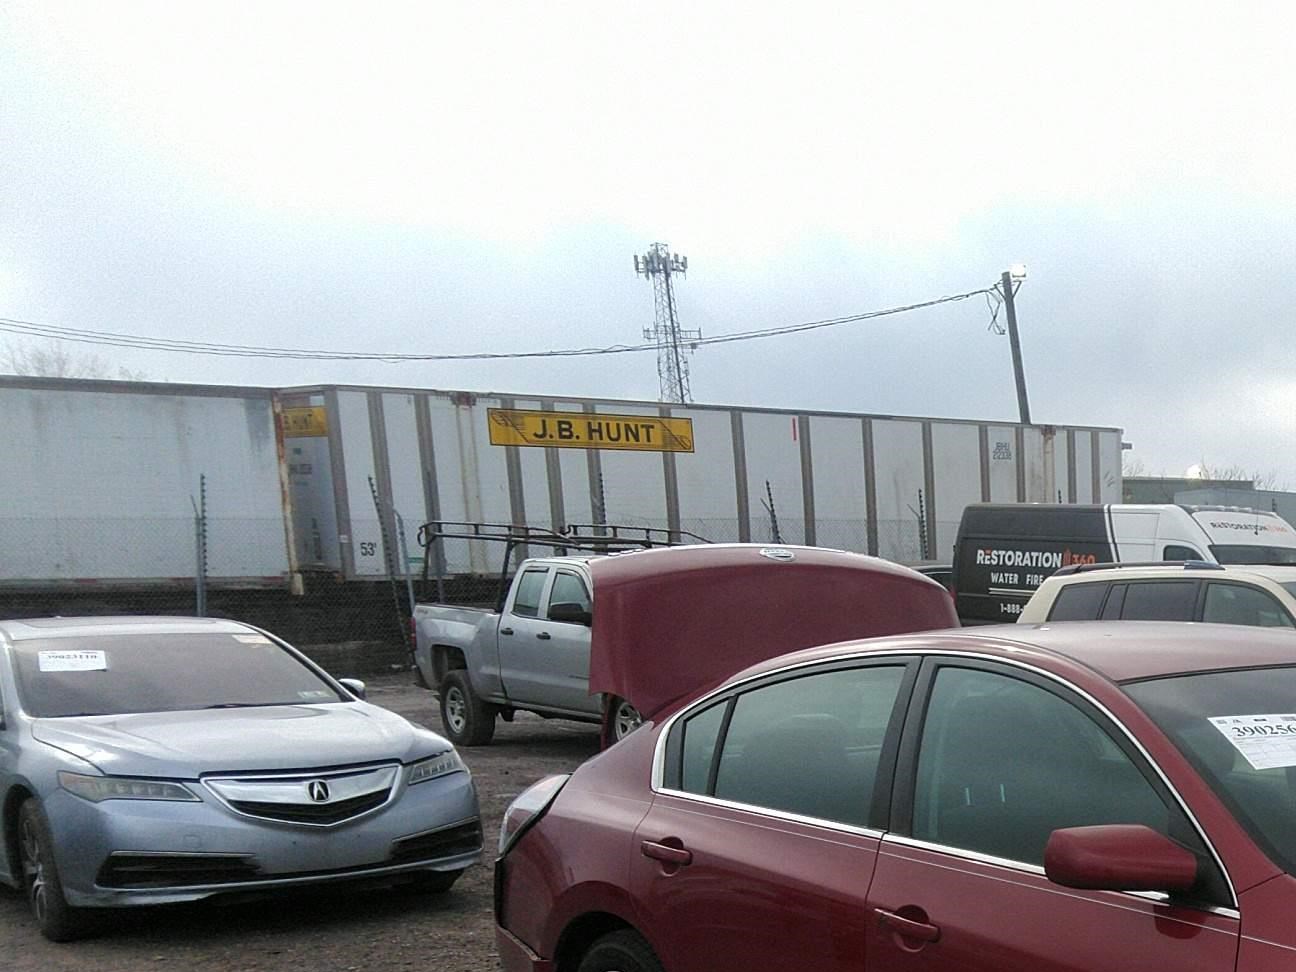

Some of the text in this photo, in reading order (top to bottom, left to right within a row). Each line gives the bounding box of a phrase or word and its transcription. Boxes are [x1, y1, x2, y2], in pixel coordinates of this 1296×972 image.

[532, 419, 656, 443] J.B. HUNT
[976, 549, 1063, 568] RESTORATION
[990, 572, 1044, 586] WATER FIRE
